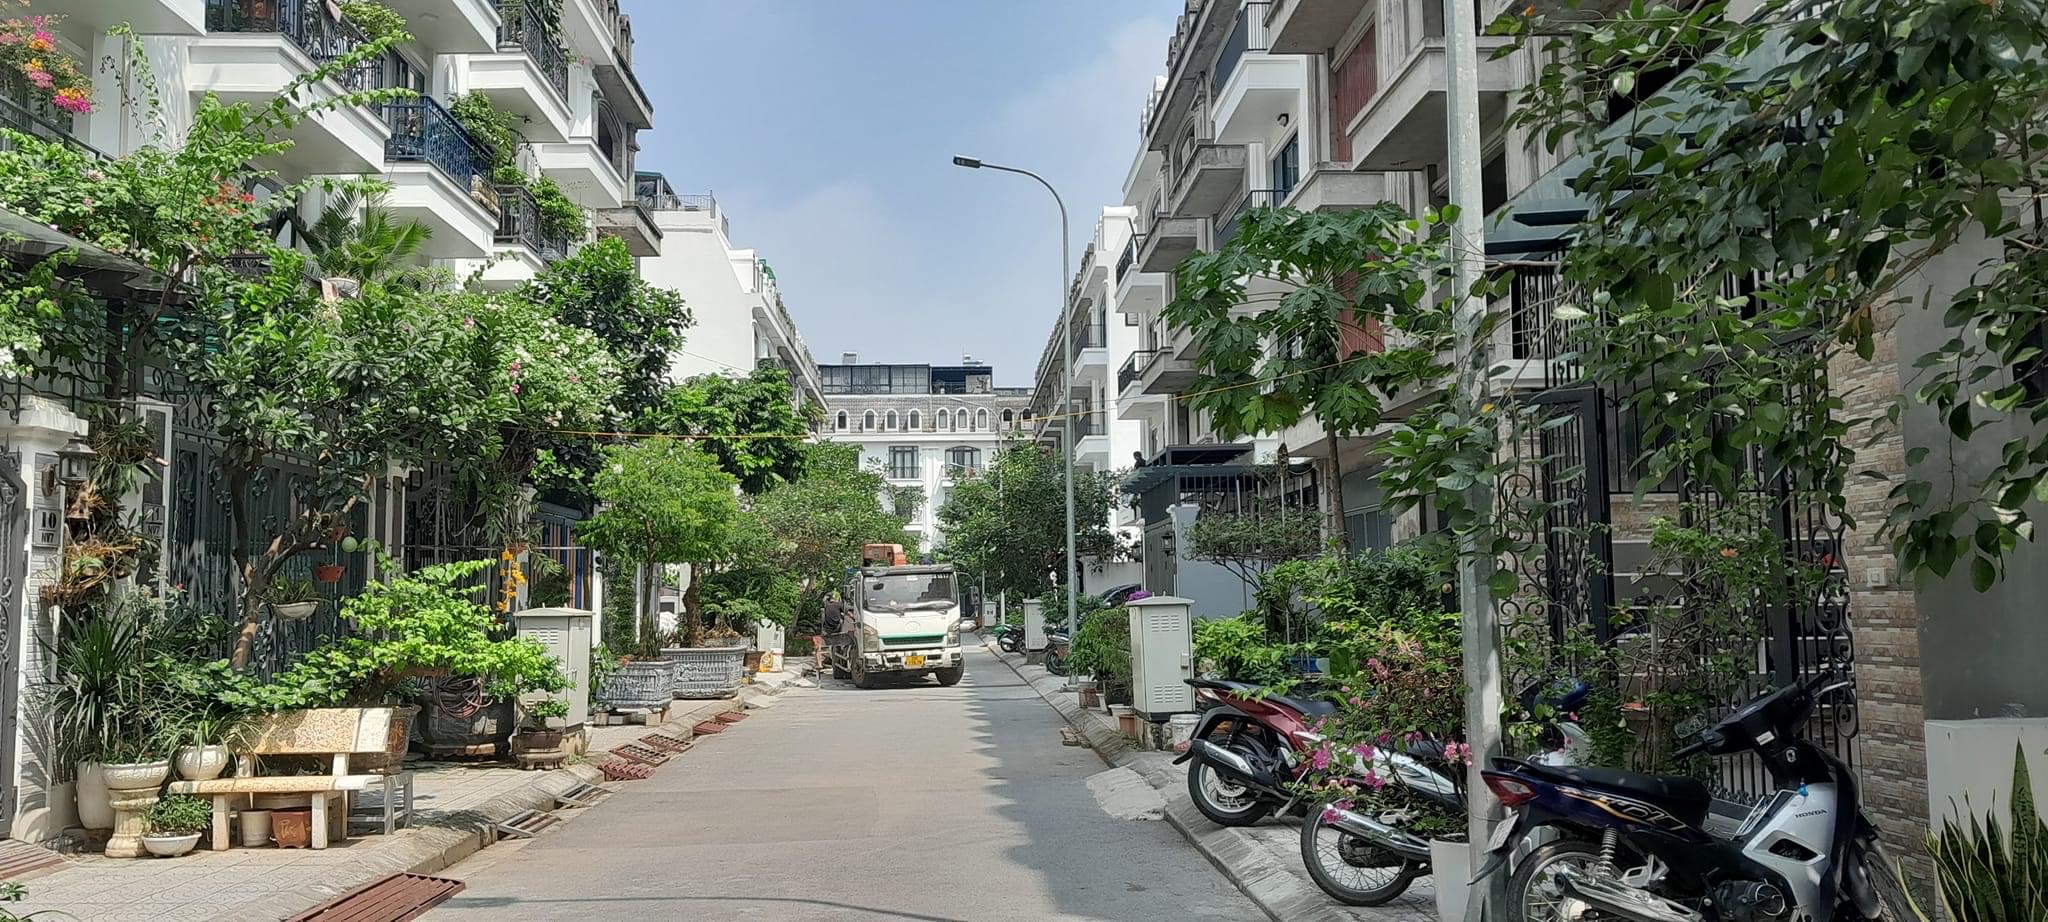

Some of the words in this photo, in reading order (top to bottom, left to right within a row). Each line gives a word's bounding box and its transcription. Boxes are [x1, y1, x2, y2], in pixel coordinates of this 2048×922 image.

[42, 511, 57, 529] 10
[147, 525, 160, 535] NV7
[41, 532, 54, 543] NV7
[1795, 809, 1828, 819] HONDA
